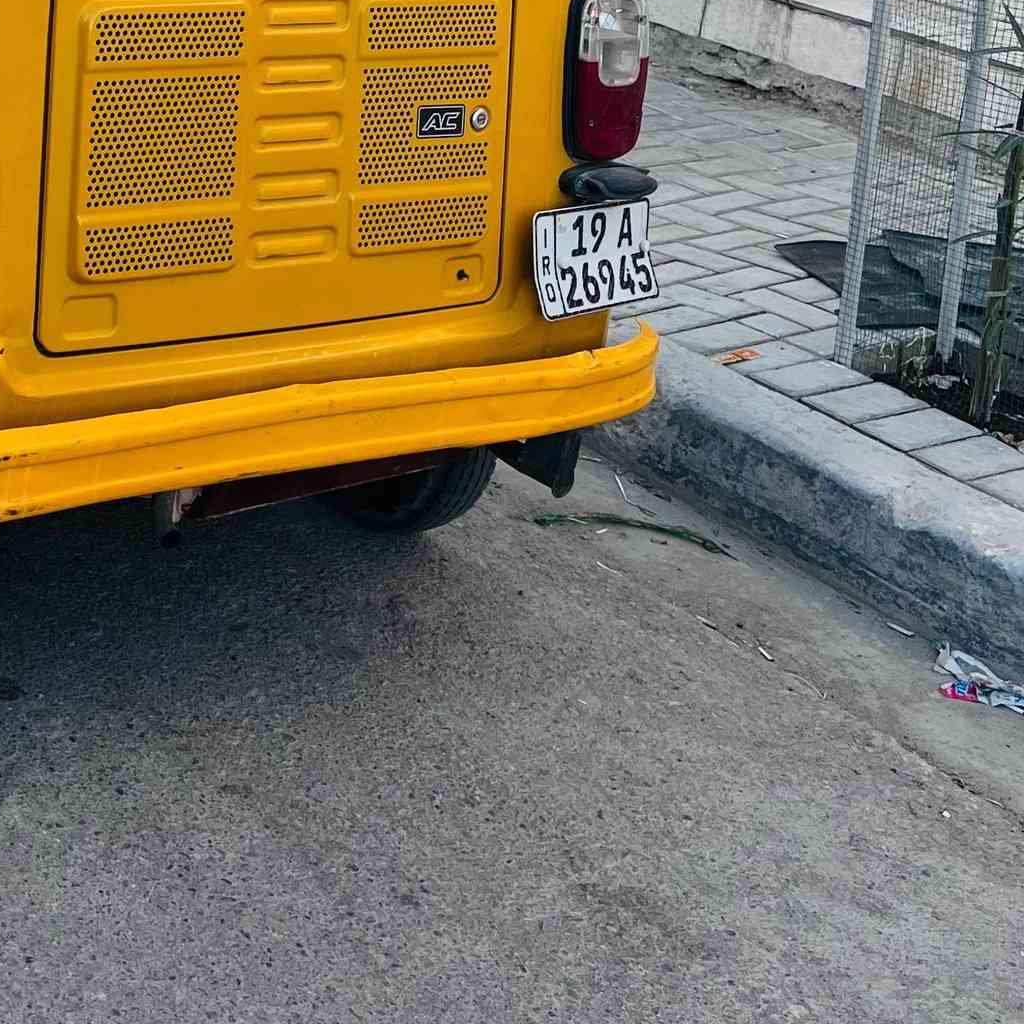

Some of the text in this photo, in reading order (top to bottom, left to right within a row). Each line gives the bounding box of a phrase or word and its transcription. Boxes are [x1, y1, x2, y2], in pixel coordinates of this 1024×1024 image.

[422, 111, 461, 131] AC
[571, 207, 633, 257] 19 A
[560, 250, 652, 309] 26945
